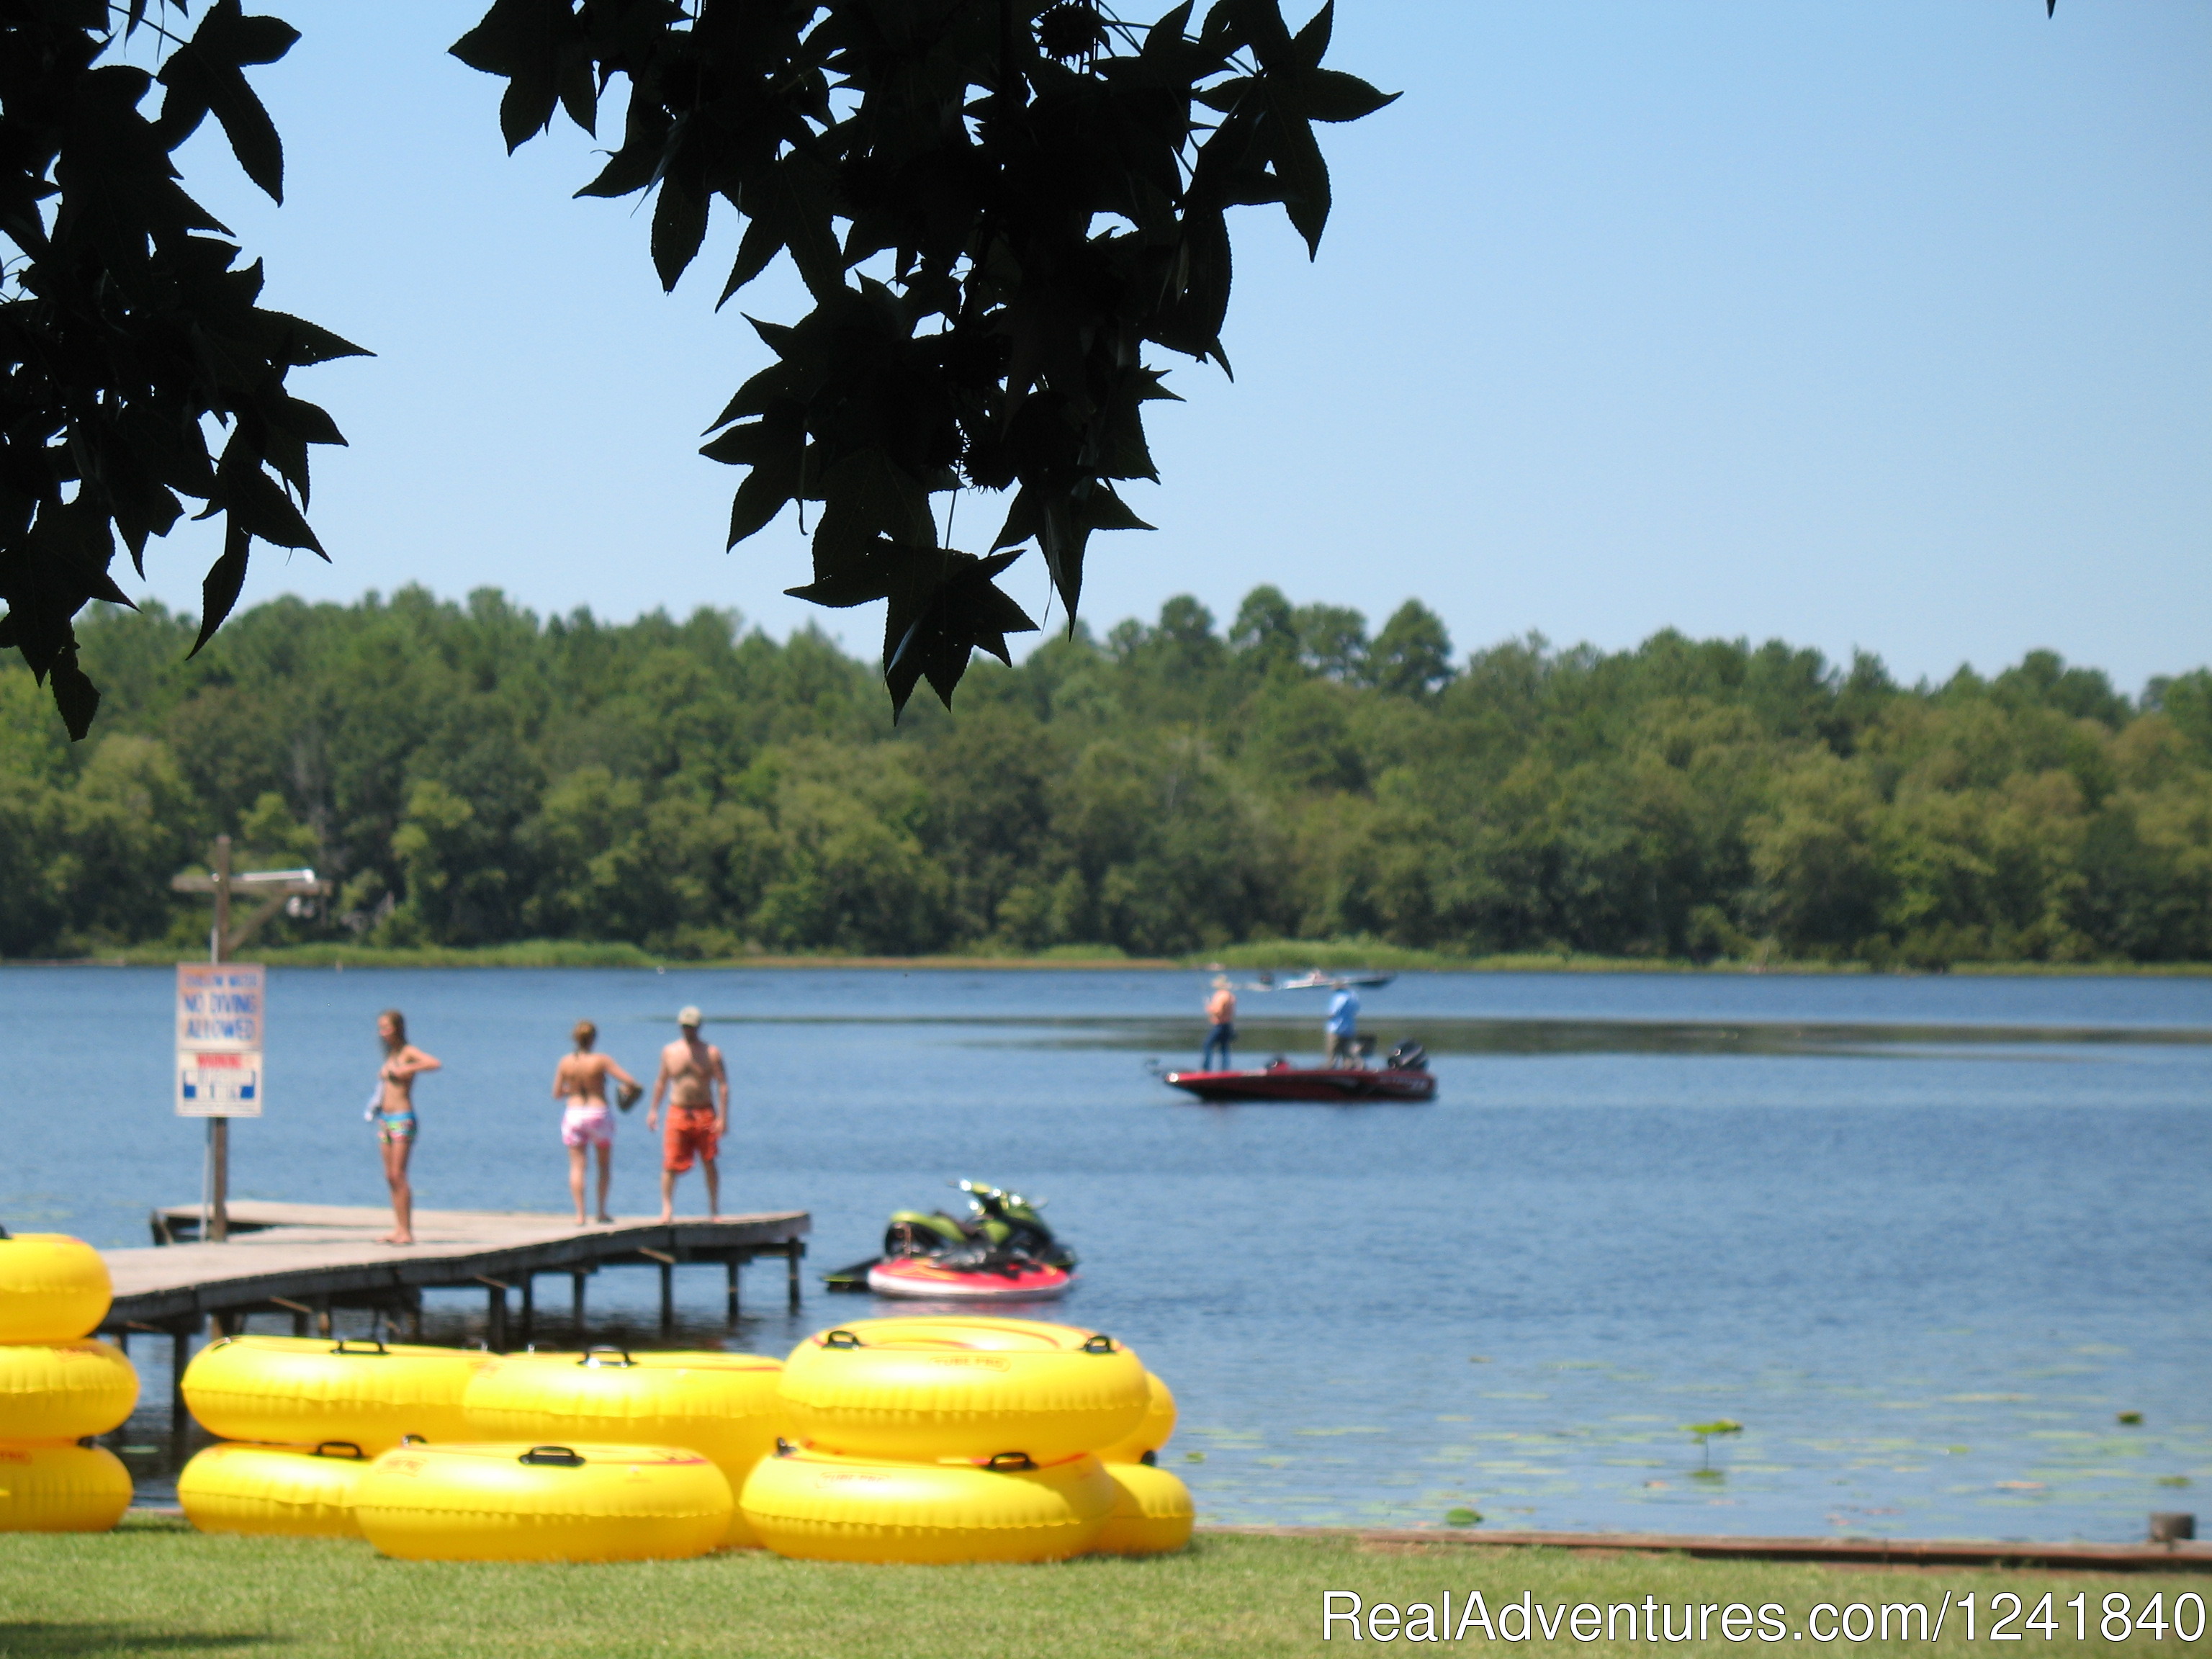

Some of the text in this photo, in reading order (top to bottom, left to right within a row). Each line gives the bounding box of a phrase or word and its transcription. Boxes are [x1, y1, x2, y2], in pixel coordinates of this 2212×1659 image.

[185, 994, 257, 1013] NO DIVING
[186, 1018, 256, 1039] ALLOWED
[934, 1358, 969, 1367] TUBE
